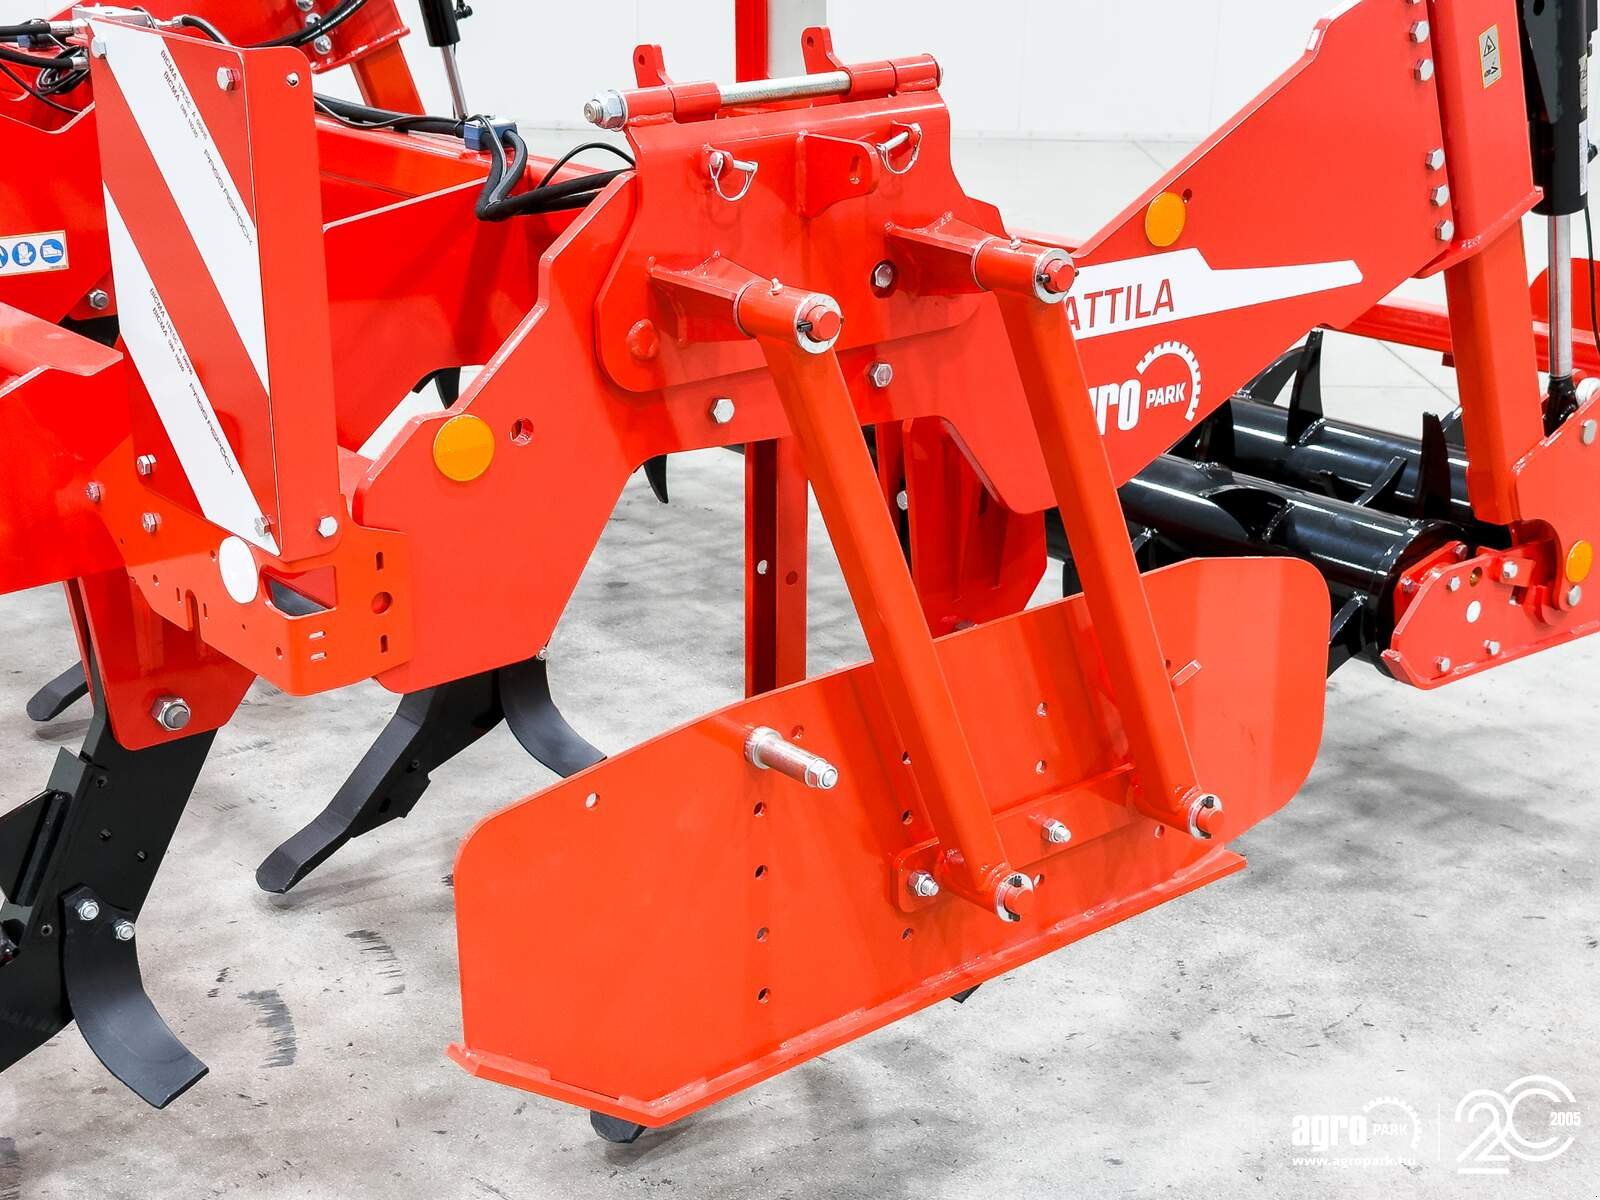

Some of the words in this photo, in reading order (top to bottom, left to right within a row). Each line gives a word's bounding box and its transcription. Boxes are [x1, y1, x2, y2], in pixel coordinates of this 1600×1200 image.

[160, 50, 177, 81] BICMA
[163, 71, 180, 102] BICMA
[150, 287, 165, 317] BICMA
[1065, 278, 1174, 331] ATTILA
[152, 307, 168, 337] BICMA
[1145, 382, 1186, 409] PARK
